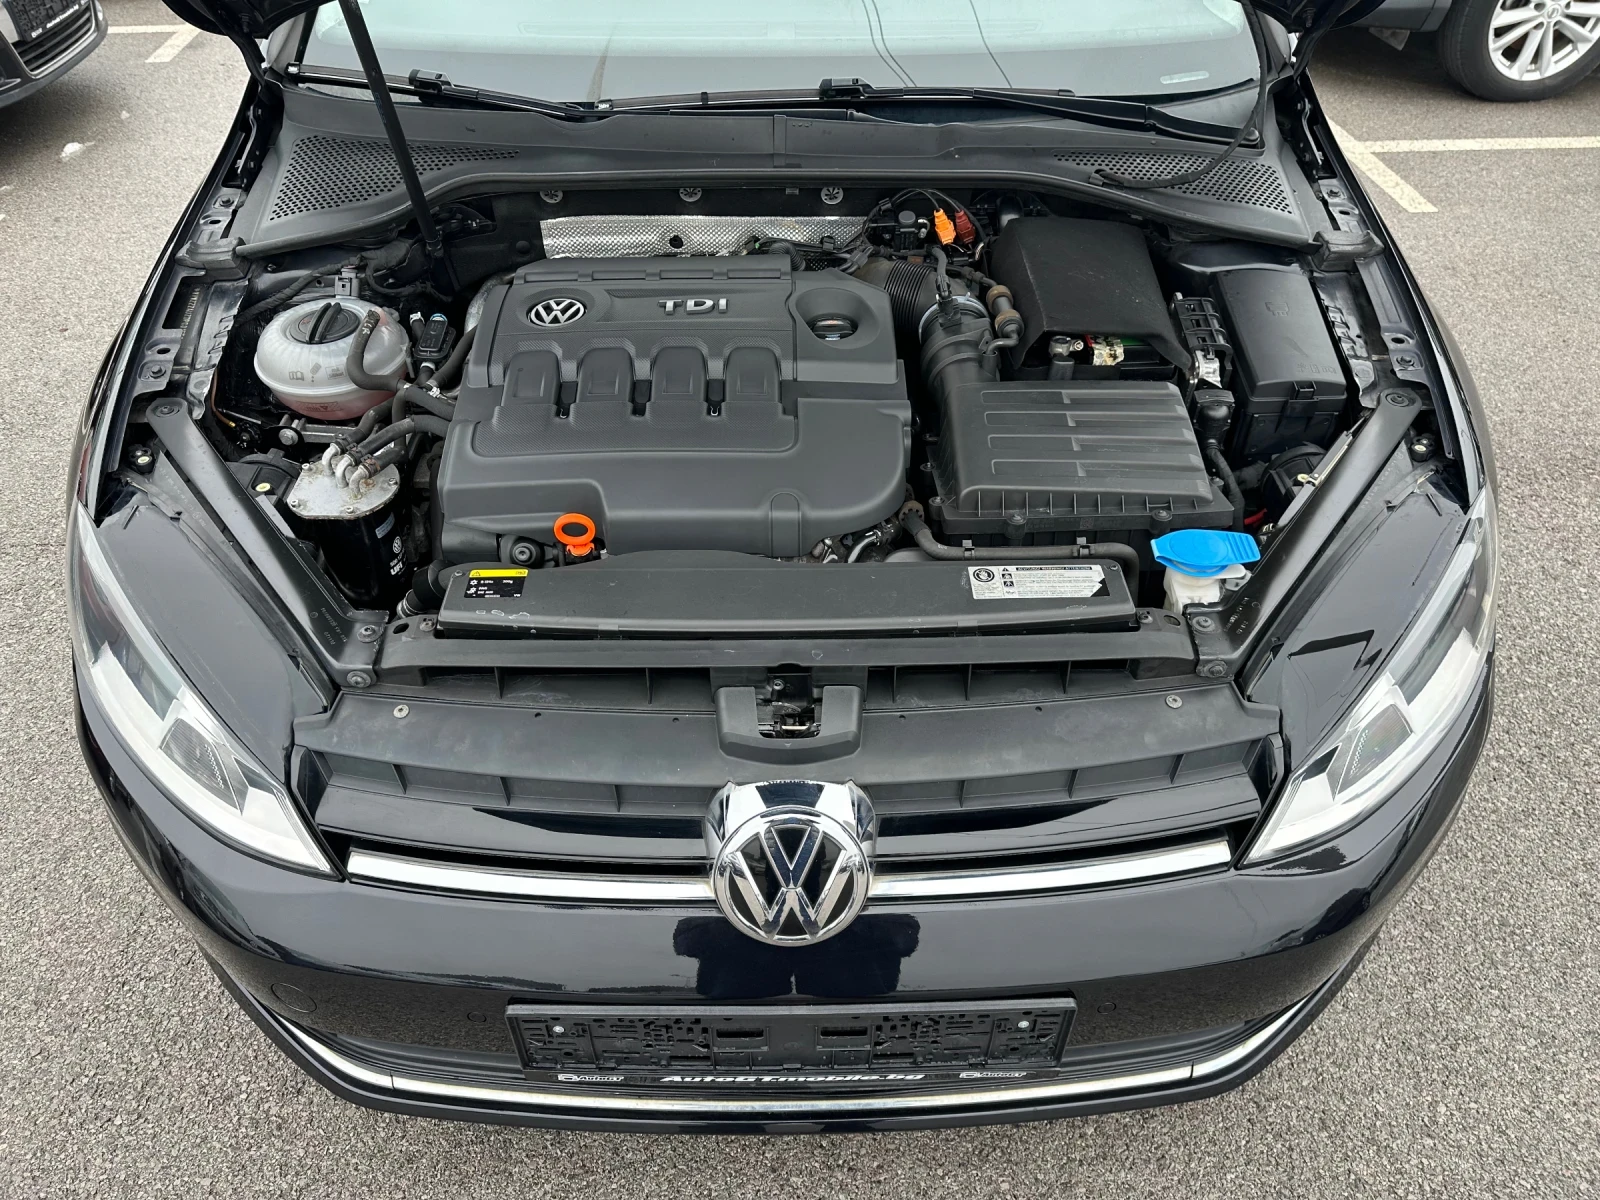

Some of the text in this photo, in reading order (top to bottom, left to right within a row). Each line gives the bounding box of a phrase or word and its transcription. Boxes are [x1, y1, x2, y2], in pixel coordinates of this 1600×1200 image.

[530, 298, 586, 327] VW
[658, 298, 727, 315] TDI
[390, 561, 403, 576] UFI
[714, 805, 869, 947] VW
